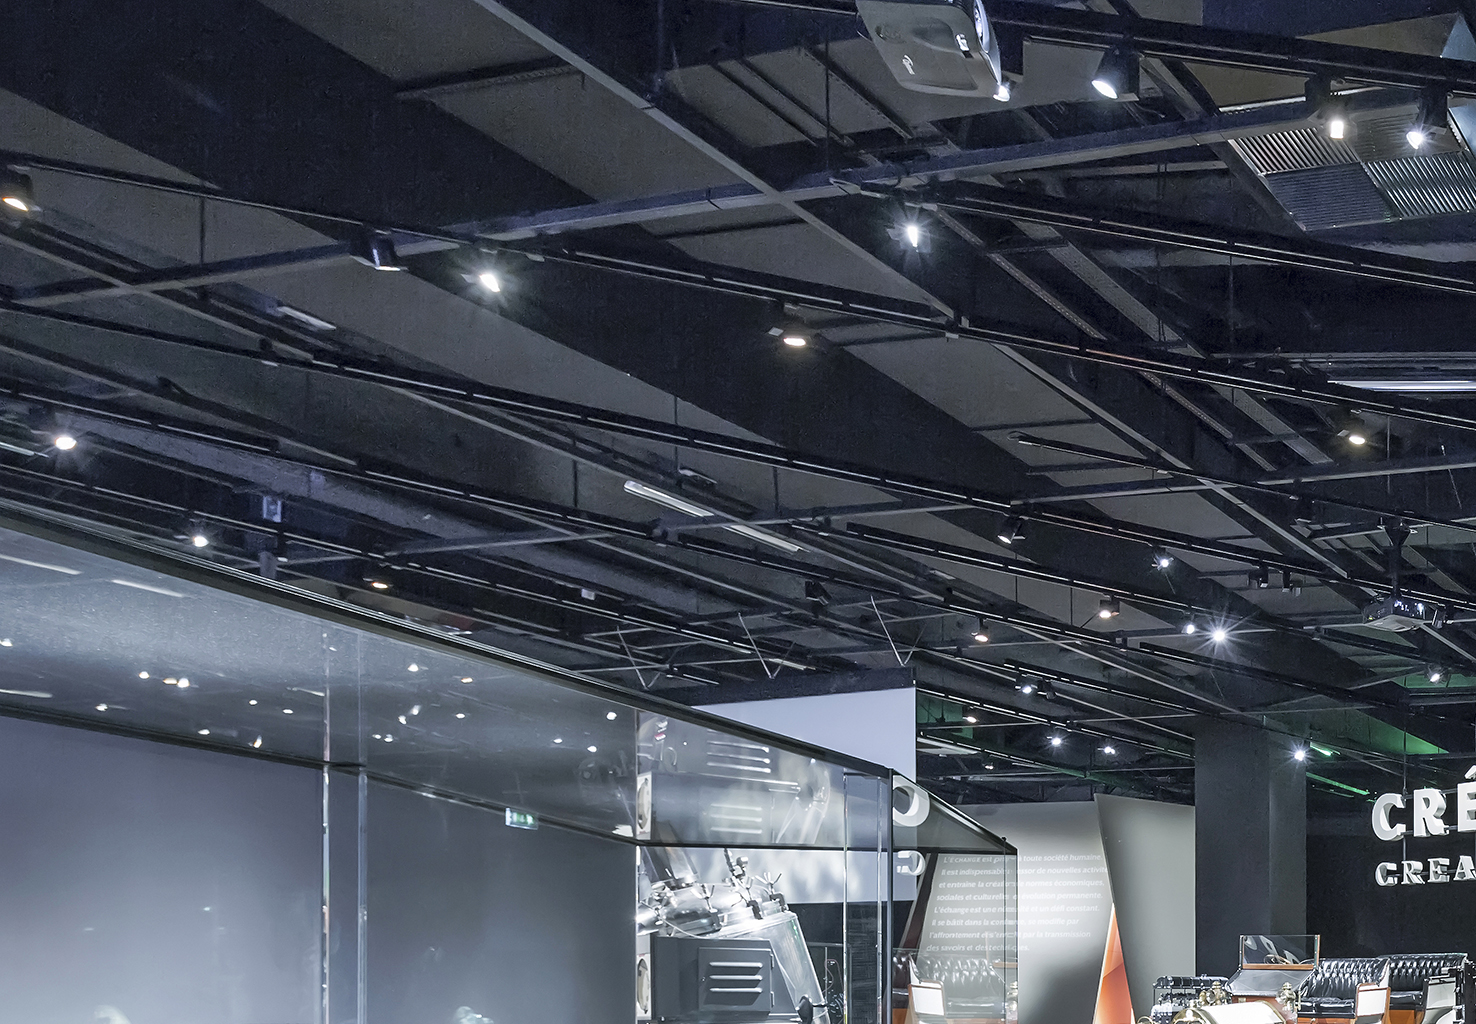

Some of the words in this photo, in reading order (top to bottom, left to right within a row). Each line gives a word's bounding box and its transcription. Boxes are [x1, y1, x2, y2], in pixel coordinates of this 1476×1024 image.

[1047, 866, 1081, 874] nouvelles
[936, 893, 964, 901] sociales
[964, 893, 972, 901] et
[1021, 892, 1058, 900] évolution
[934, 906, 970, 915] L'échange
[1066, 919, 1080, 927] par
[929, 931, 980, 939] l'affrontement
[1022, 931, 1035, 939] par
[1045, 930, 1091, 938] transmission
[926, 944, 939, 952] des
[940, 944, 965, 952] savoirs
